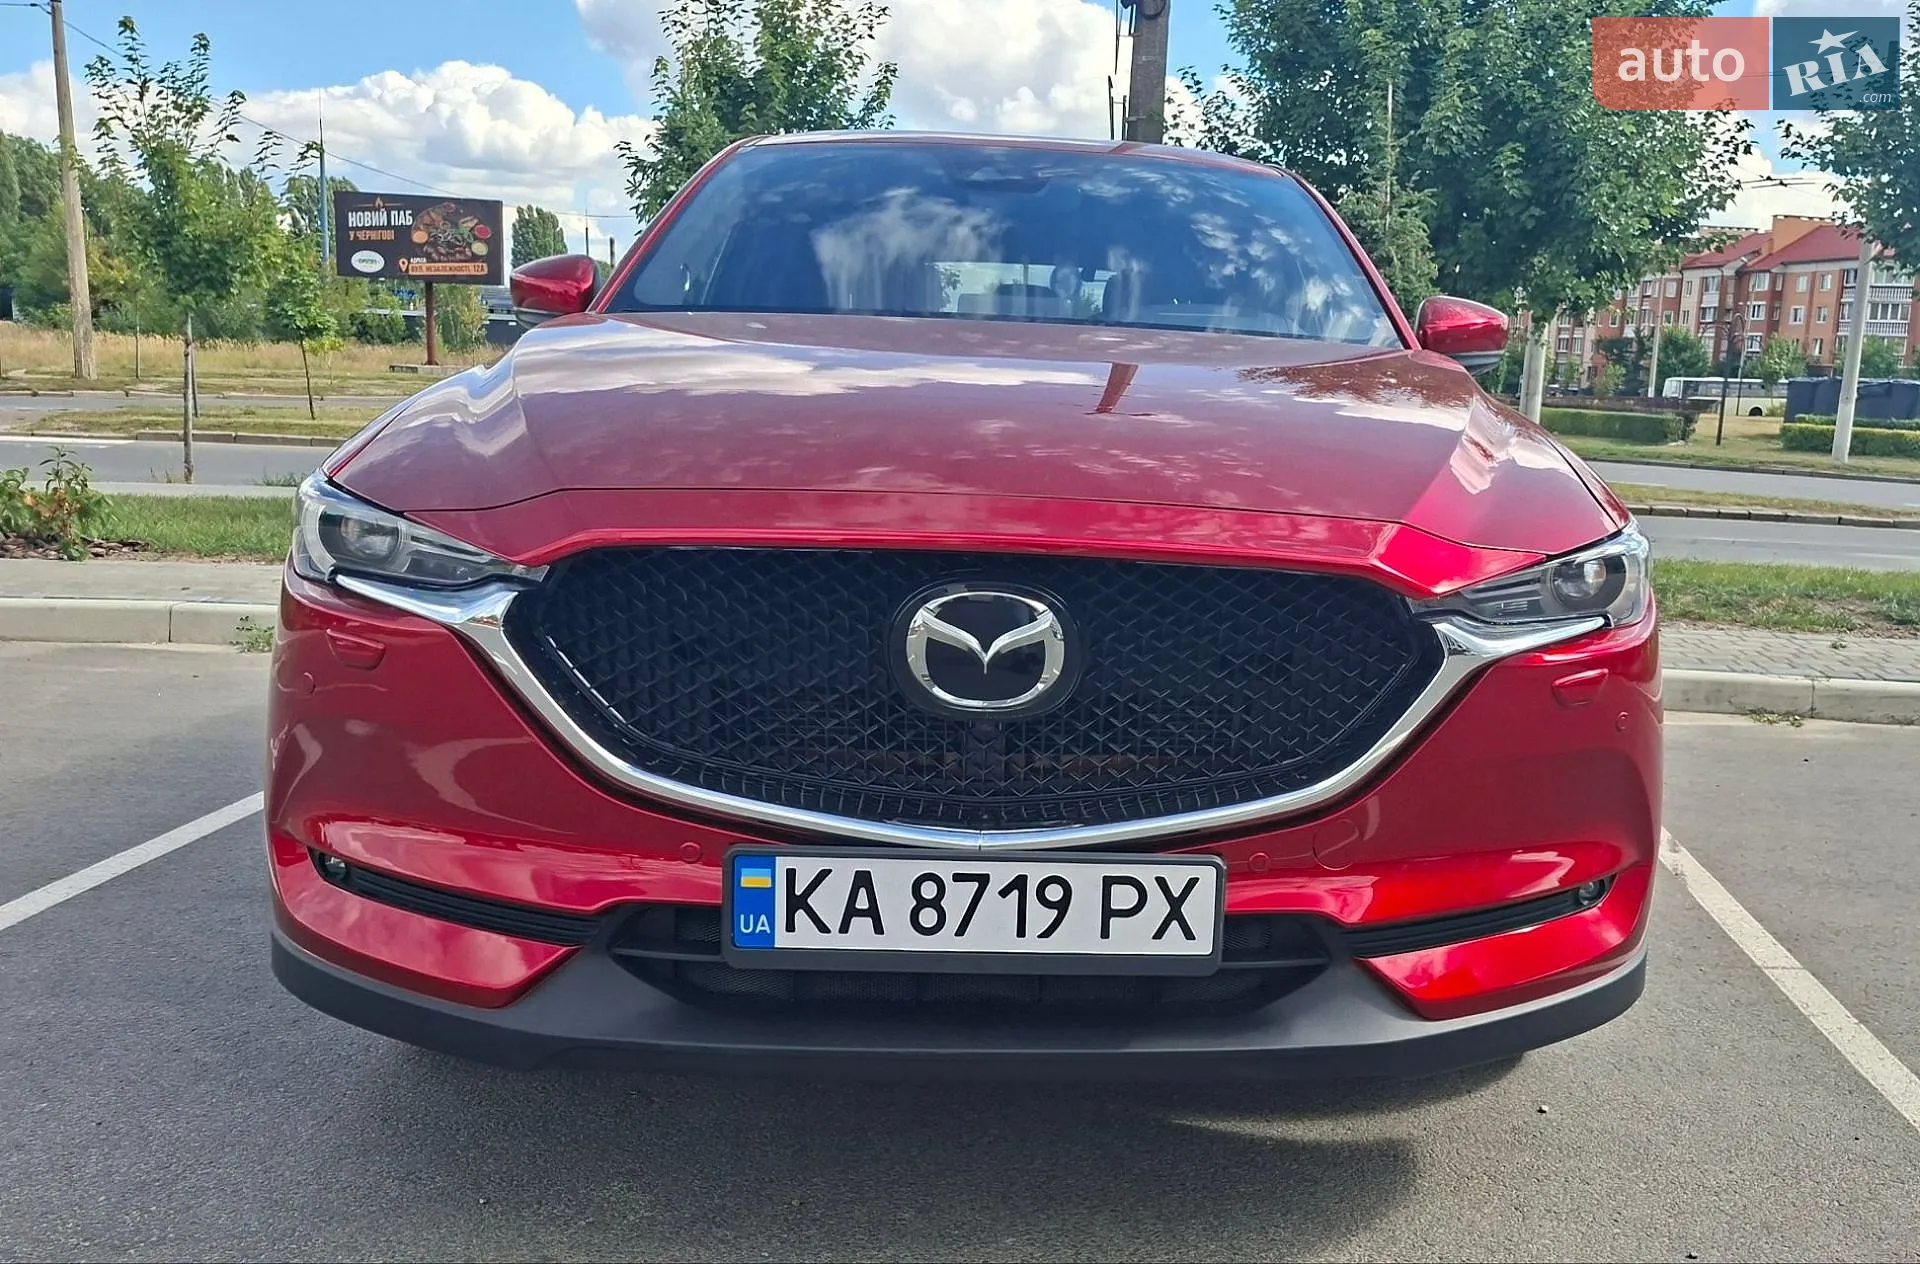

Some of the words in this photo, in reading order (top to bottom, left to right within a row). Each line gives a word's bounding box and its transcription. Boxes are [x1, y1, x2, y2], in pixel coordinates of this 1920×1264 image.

[348, 208, 387, 227] НОВИЙ
[391, 210, 413, 226] ПАБ
[784, 868, 885, 936] KA
[909, 872, 1072, 939] 8719
[1099, 875, 1201, 940] PX
[739, 914, 771, 934] UA
